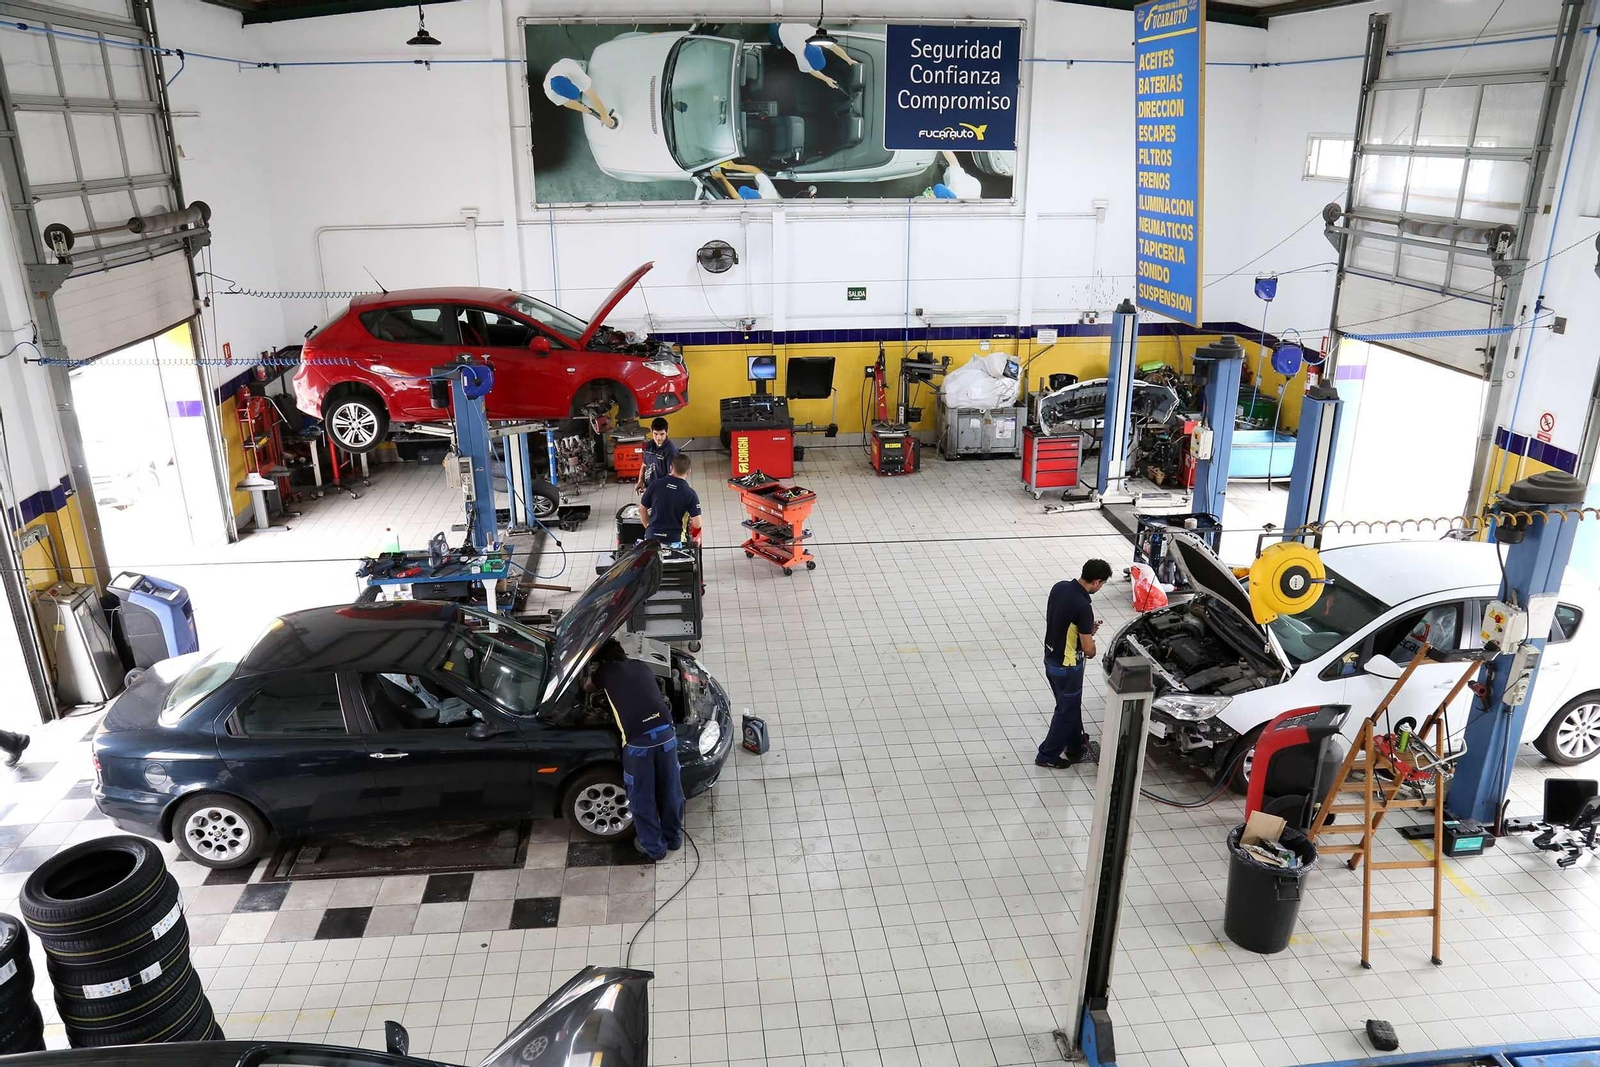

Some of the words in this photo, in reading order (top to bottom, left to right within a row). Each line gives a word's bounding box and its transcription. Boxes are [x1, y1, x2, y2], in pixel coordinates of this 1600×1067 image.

[911, 38, 1002, 63] Seguridad
[1139, 47, 1175, 71] ACEITES
[909, 64, 1001, 85] Confianza
[1138, 73, 1183, 95] BATERIAS
[897, 89, 1011, 114] Compromiso
[1138, 98, 1184, 119] DIRECCION
[1138, 124, 1176, 143] ESCAPES
[1139, 148, 1172, 167] FILTROS
[1138, 171, 1171, 191] FRENOS
[1138, 194, 1194, 217] ILUMINACION
[1139, 217, 1194, 241] NEUMATICOS
[1138, 239, 1186, 264] TAPICERIA
[1138, 260, 1170, 284] SONIDO
[848, 290, 866, 298] SALIDA
[1138, 284, 1192, 313] SUSPENSION
